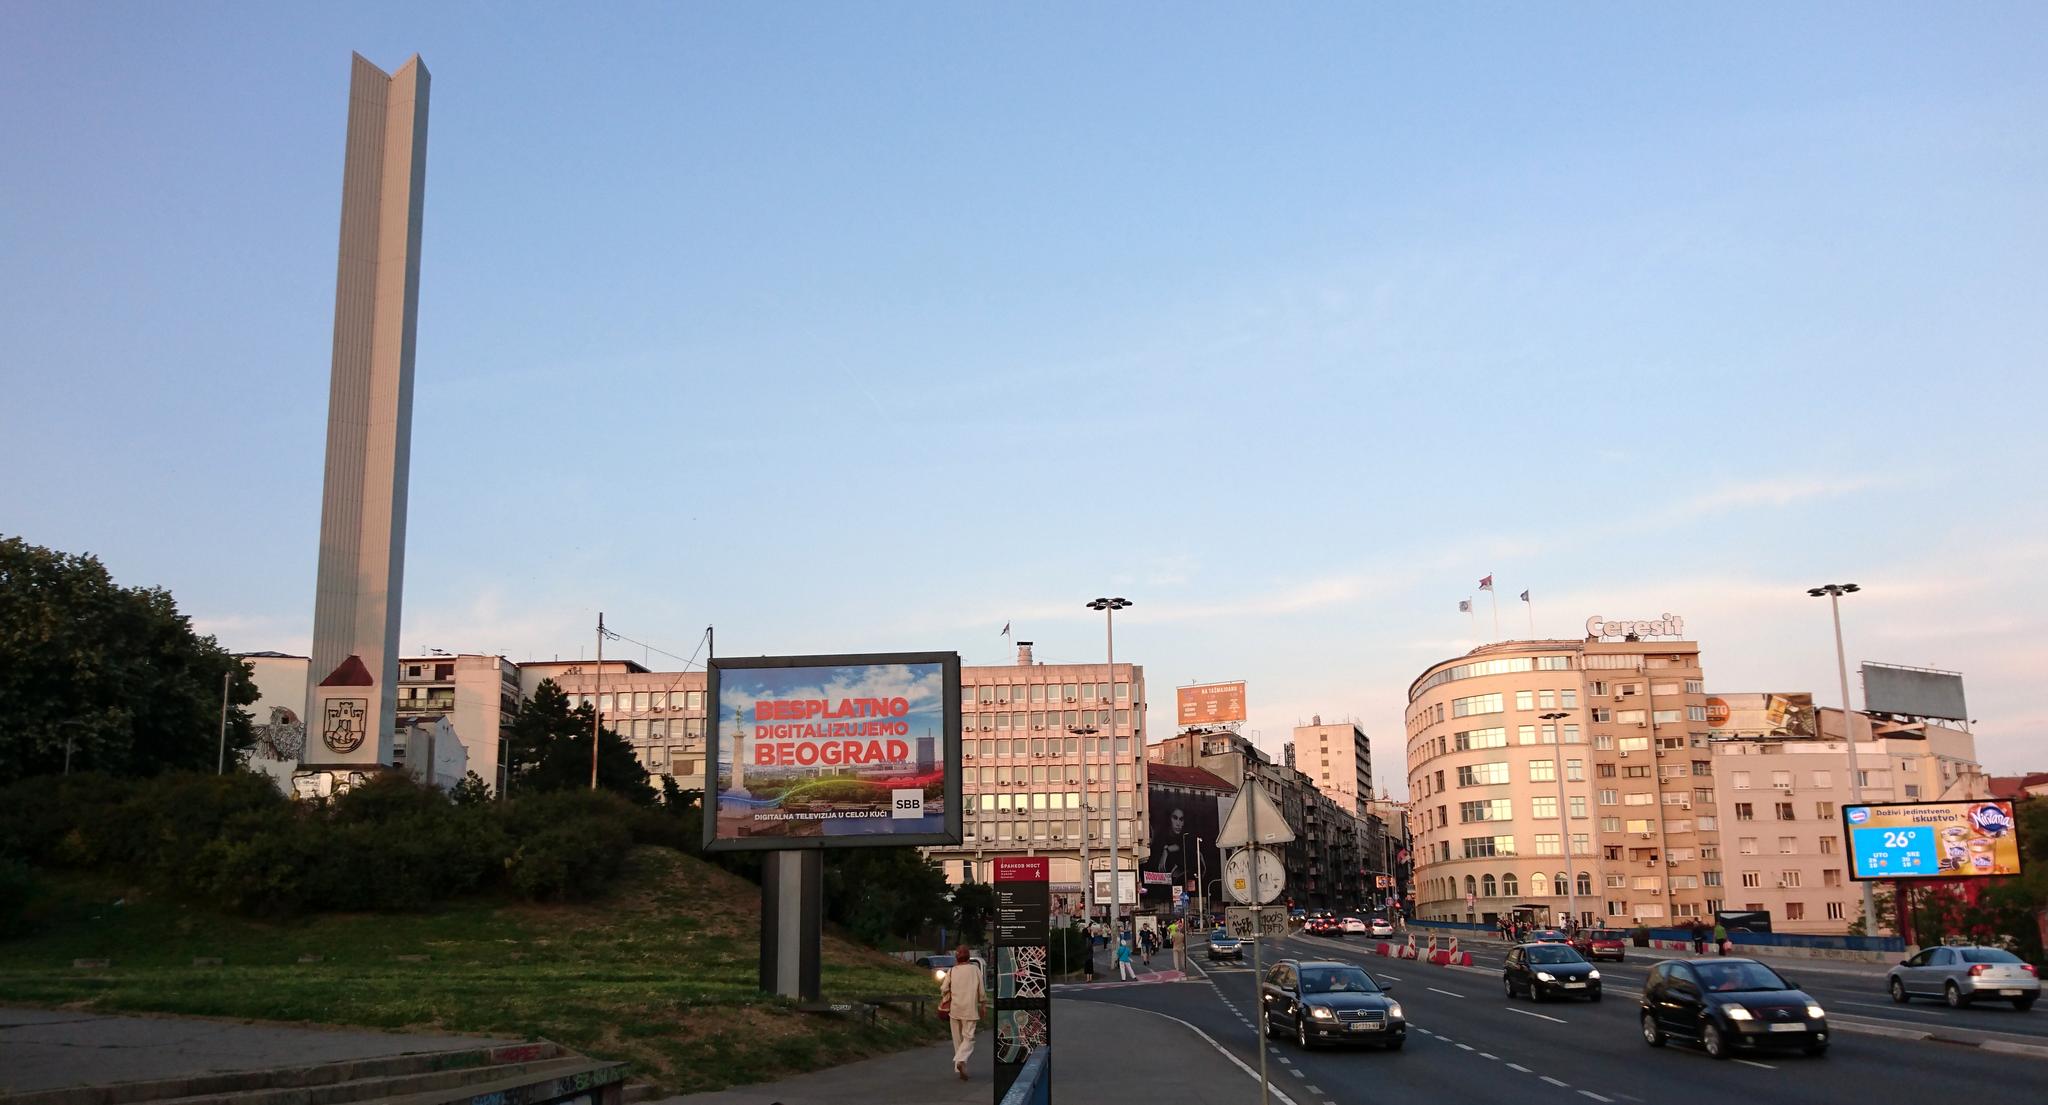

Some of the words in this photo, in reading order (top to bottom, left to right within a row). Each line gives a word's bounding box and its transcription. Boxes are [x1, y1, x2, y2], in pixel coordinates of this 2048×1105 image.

[1586, 613, 1684, 637] Ceresit
[754, 696, 909, 721] BESPLATNO
[755, 721, 909, 740] DIGITALIZUJEMO
[754, 739, 909, 766] BEOGRAD
[896, 799, 920, 810] SBB
[1876, 809, 1901, 817] Doživi
[1903, 808, 1951, 817] jedinstveno
[754, 812, 794, 821] DIGITALNA
[795, 811, 837, 820] TELEVIZIJA
[838, 811, 844, 819] U
[845, 811, 868, 819] CELOJ
[869, 809, 887, 818] KUĆI
[1912, 813, 1958, 823] iskustvo!
[1970, 806, 2010, 829] Nirvana
[1883, 831, 1916, 848] 26°
